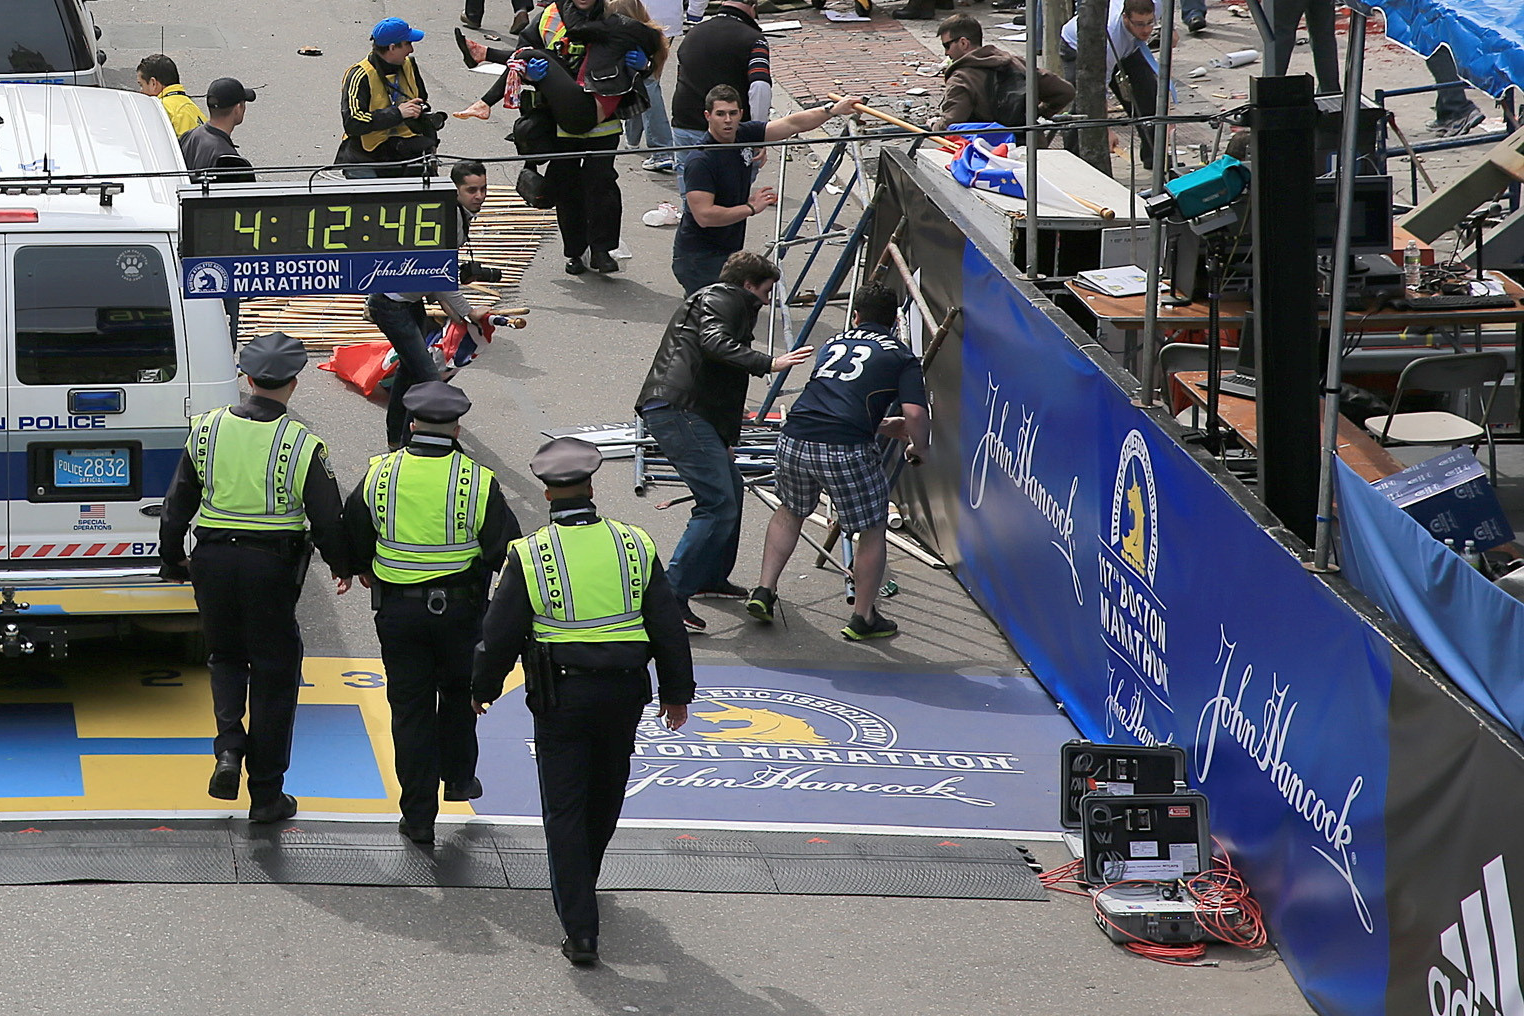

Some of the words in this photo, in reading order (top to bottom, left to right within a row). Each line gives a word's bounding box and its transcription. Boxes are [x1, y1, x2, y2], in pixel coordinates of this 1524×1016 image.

[234, 202, 442, 250] 4:12:46
[233, 261, 270, 277] 2013
[275, 259, 340, 274] BOSTON
[233, 275, 342, 293] MARATHON
[357, 259, 398, 292] John
[394, 257, 456, 284] Hancock
[815, 343, 872, 382] 23
[19, 415, 106, 430] POLICE
[58, 459, 84, 477] POLICE
[83, 458, 126, 478] 2832
[197, 425, 210, 481] BOSTO
[275, 442, 292, 505] POLICE
[456, 467, 472, 531] POLICE
[1011, 403, 1084, 606] Hancock
[538, 542, 564, 610] BOSTON
[622, 532, 641, 599] POLICE
[1119, 574, 1167, 654] BOSTON
[1099, 592, 1170, 693] MARATHON
[775, 691, 888, 746] ASSOCIATION
[742, 744, 1013, 770] MARATHON
[1195, 622, 1258, 785] John
[1253, 671, 1374, 935] Hancock
[736, 765, 996, 808] Hancock
